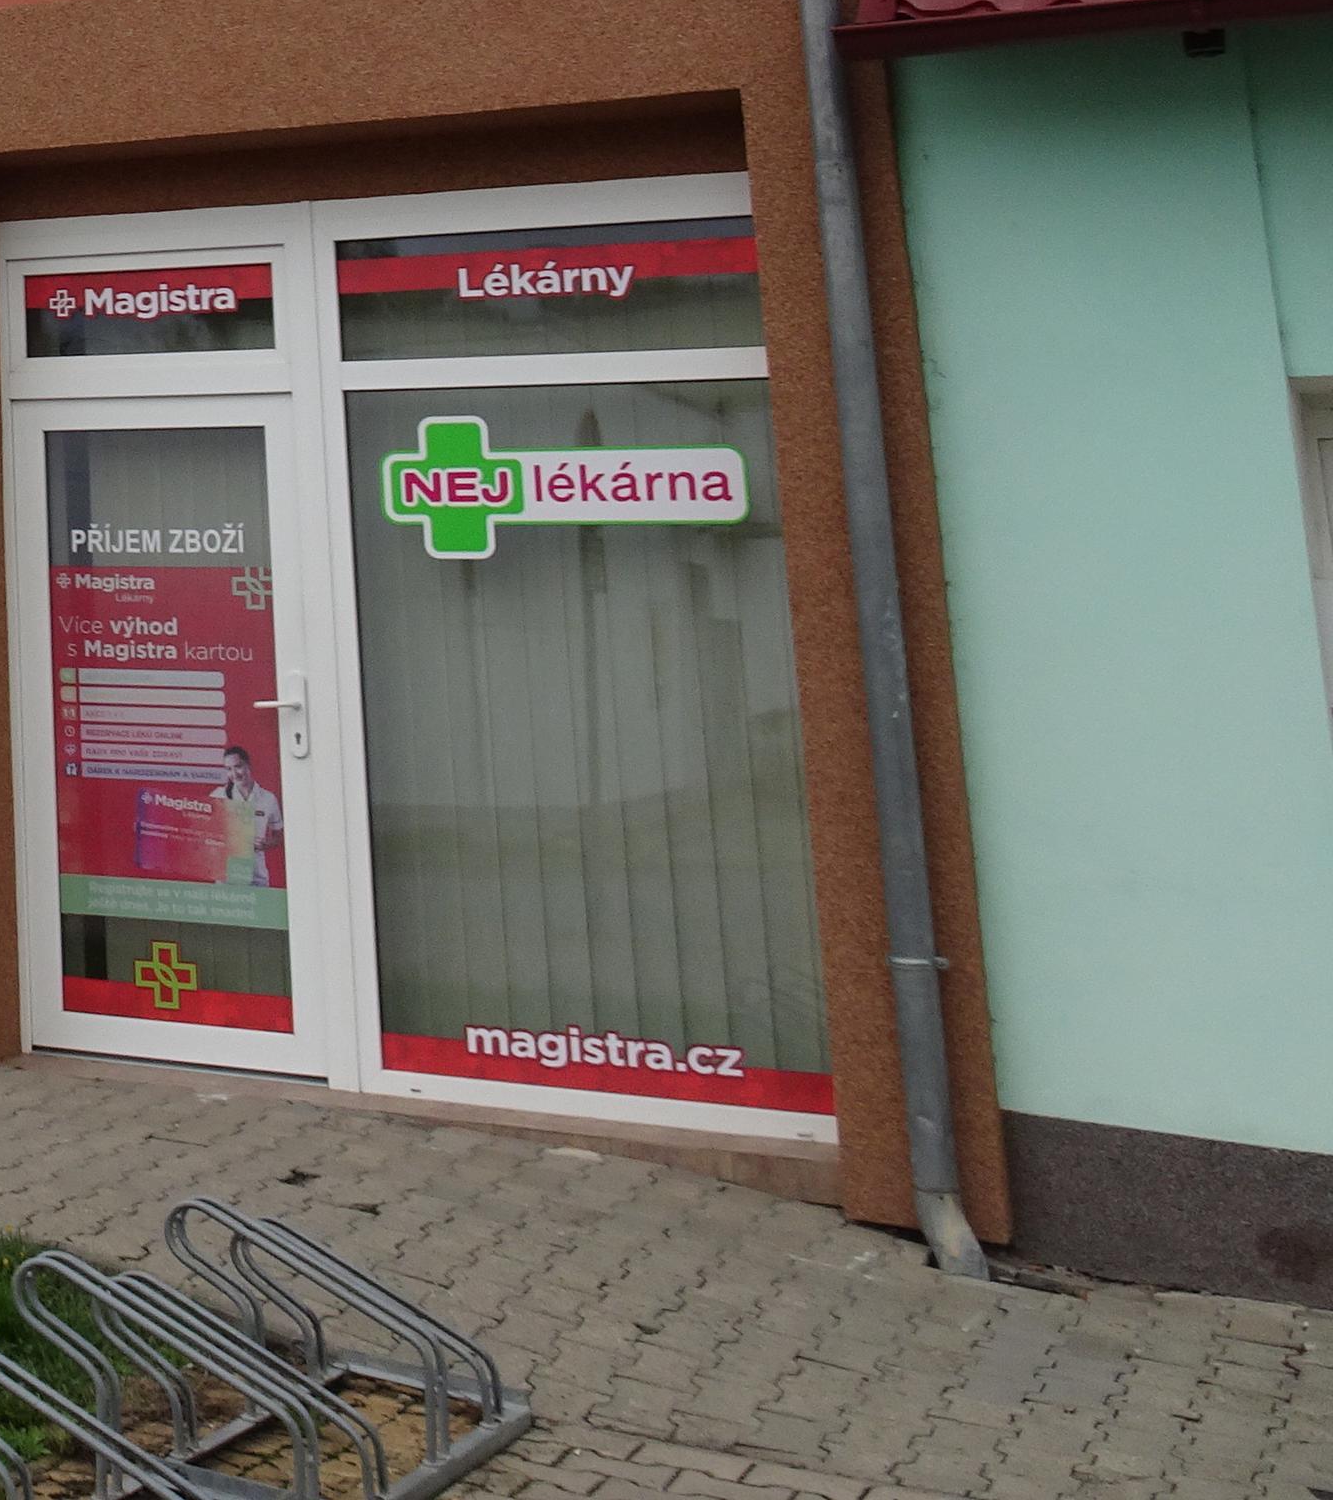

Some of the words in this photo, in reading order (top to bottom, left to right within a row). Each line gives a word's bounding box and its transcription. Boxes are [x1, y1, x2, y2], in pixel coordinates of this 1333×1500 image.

[84, 281, 236, 321] Magistra
[456, 261, 635, 300] Lékárny
[402, 470, 511, 504] NEJ
[533, 461, 734, 502] lékárna
[70, 523, 162, 553] PŘÍJEM
[168, 522, 245, 553] ZBOŽÍ
[75, 573, 155, 592] Magistra
[109, 616, 178, 638] výhod
[67, 643, 78, 656] s
[84, 639, 178, 661] Magistra
[185, 641, 254, 661] kartou
[154, 794, 213, 814] Magistra
[464, 1023, 745, 1079] magistra.cz
